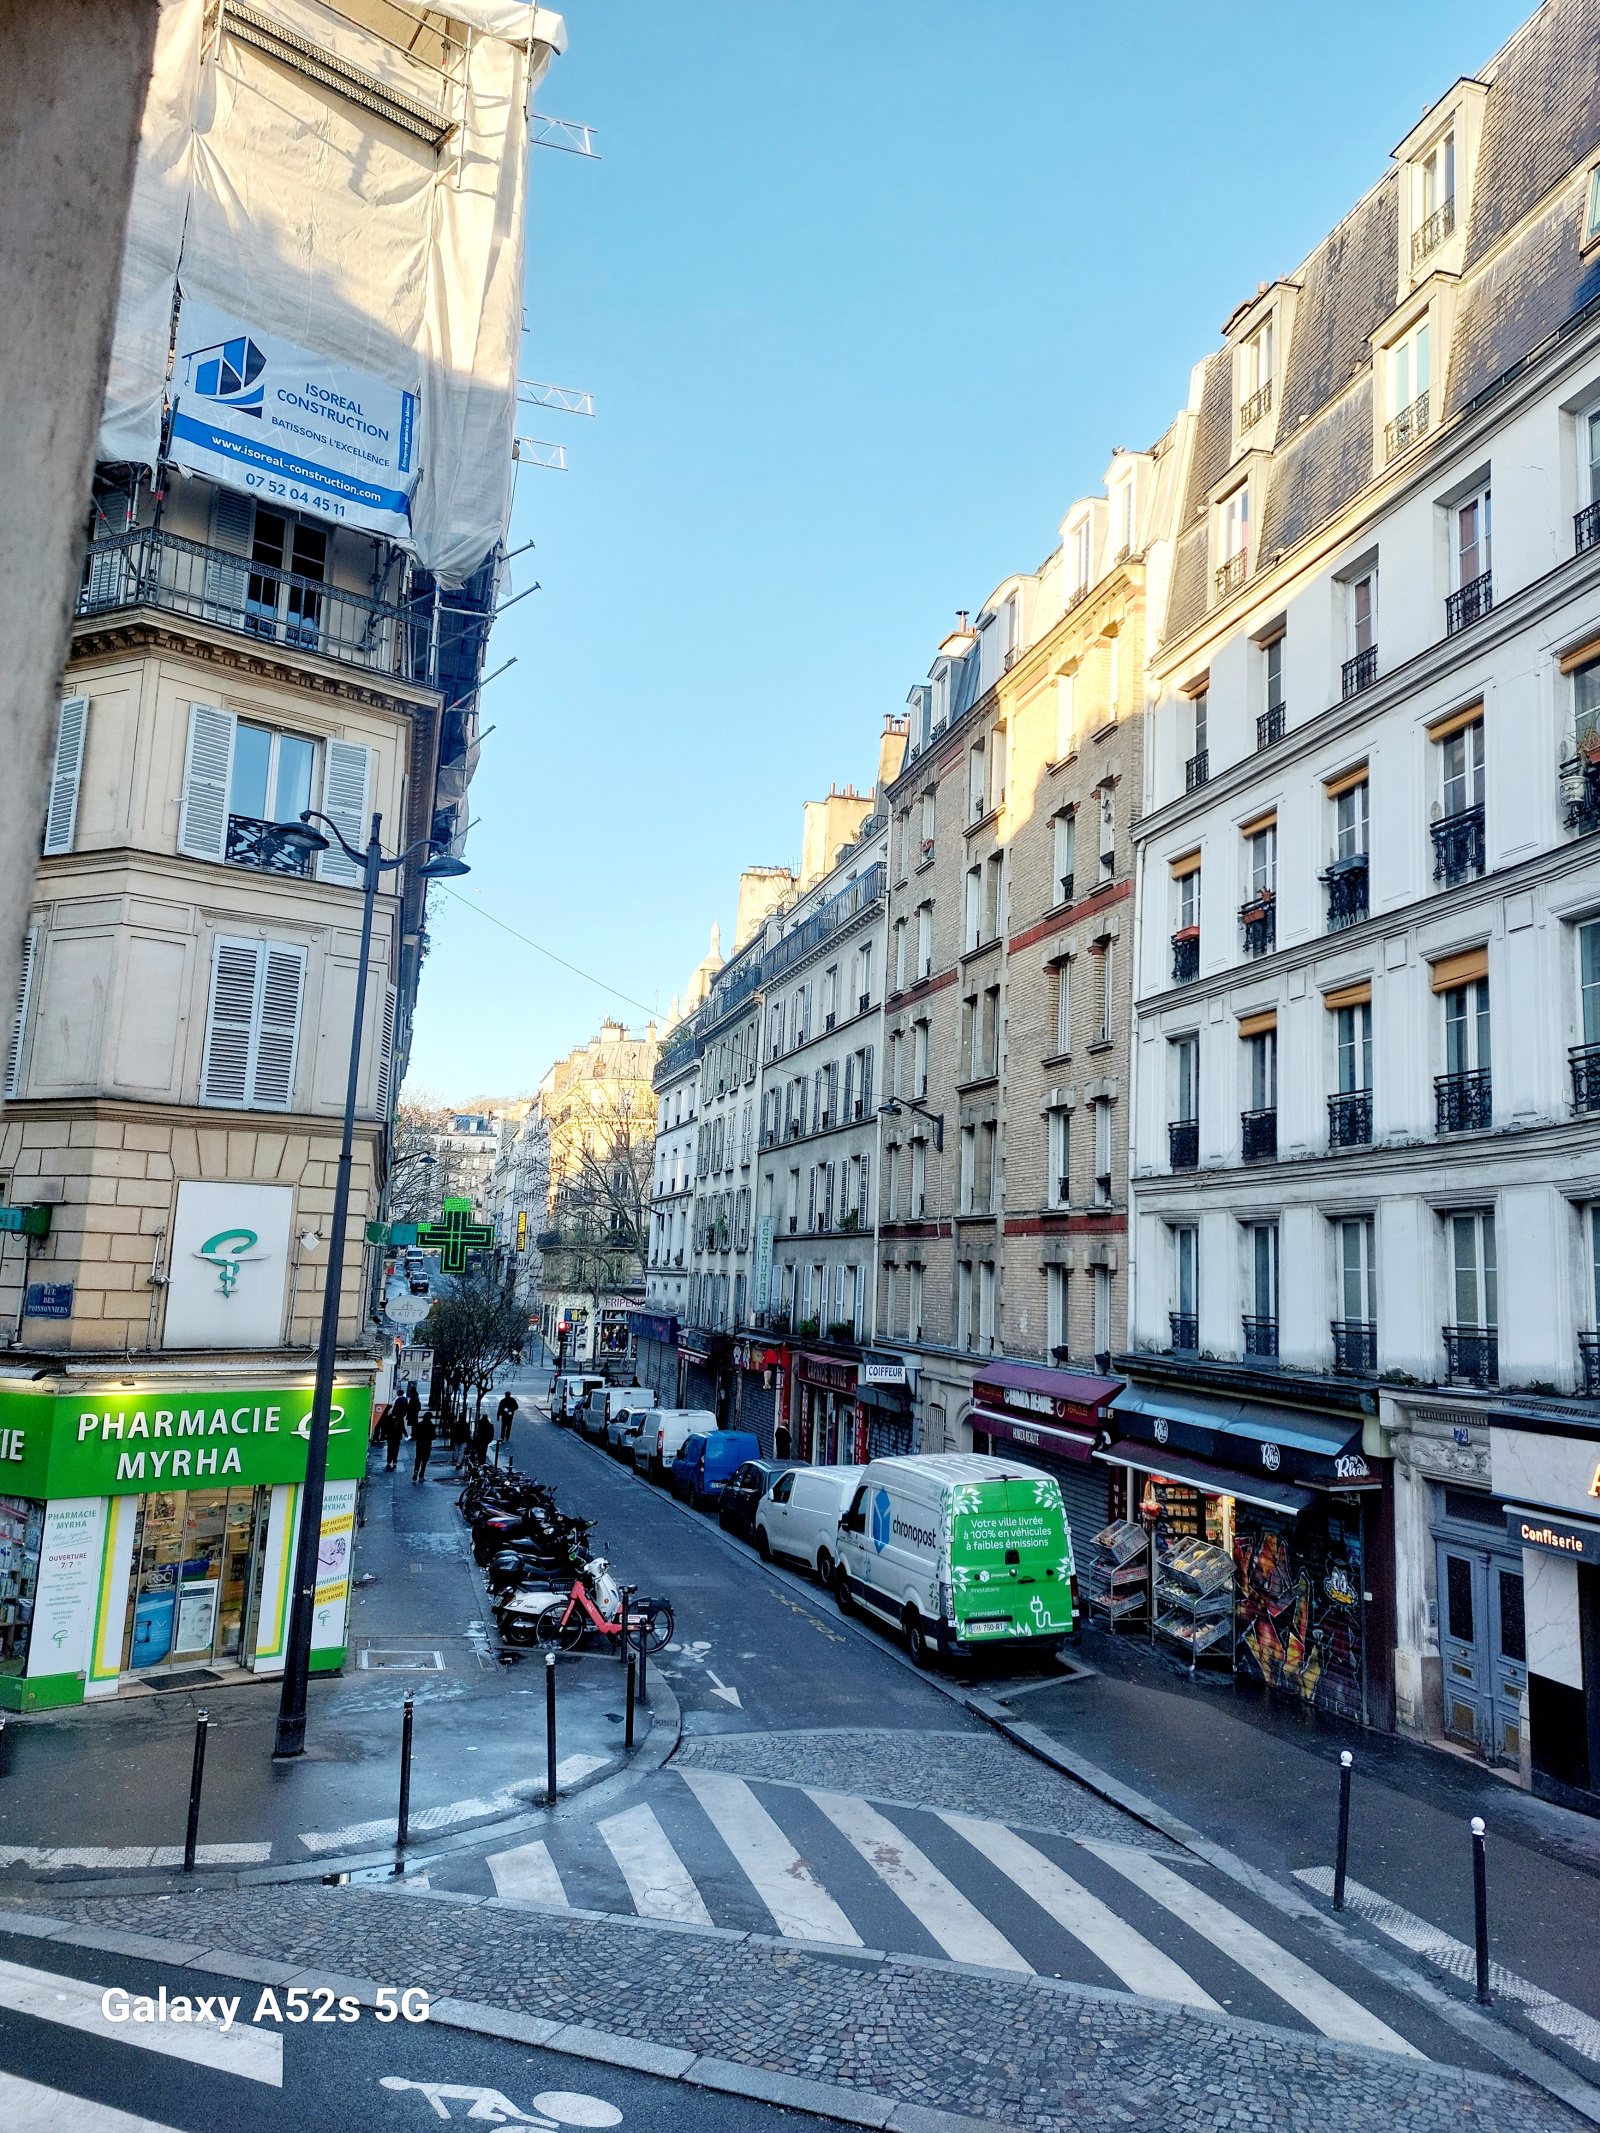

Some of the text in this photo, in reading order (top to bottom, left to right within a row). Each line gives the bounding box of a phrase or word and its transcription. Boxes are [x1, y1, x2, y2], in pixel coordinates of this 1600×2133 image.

[305, 382, 364, 416] ISOREAL
[277, 389, 389, 441] CONSTRUCTION
[272, 416, 390, 467] BATISSONS L'EXCELLENCE
[211, 435, 382, 502] www.isoreal-construction.com
[245, 473, 346, 517] 07 52 04 45 11
[517, 1233, 525, 1250] HOTEL
[868, 1366, 903, 1377] COIFFEUR
[77, 1406, 281, 1441] PHARMACIE
[1454, 1428, 1467, 1441] 72
[0, 1428, 25, 1461] IE
[116, 1447, 242, 1480] MYRHA
[323, 1493, 354, 1502] ARMACIE
[47, 1510, 96, 1520] PHARMACIE
[56, 1520, 87, 1529] MYRHA
[971, 1516, 1043, 1528] Votre ville livrée
[892, 1514, 937, 1549] chronopost
[963, 1527, 1052, 1540] à 100% en véhicules
[1521, 1524, 1584, 1552] Confiserie
[966, 1538, 1049, 1550] à faibles émissions
[48, 1552, 87, 1562] OUVERTURE
[61, 1561, 74, 1569] 7/7
[149, 1571, 172, 1584] RoC
[969, 1609, 1006, 1617] chronopost.fr
